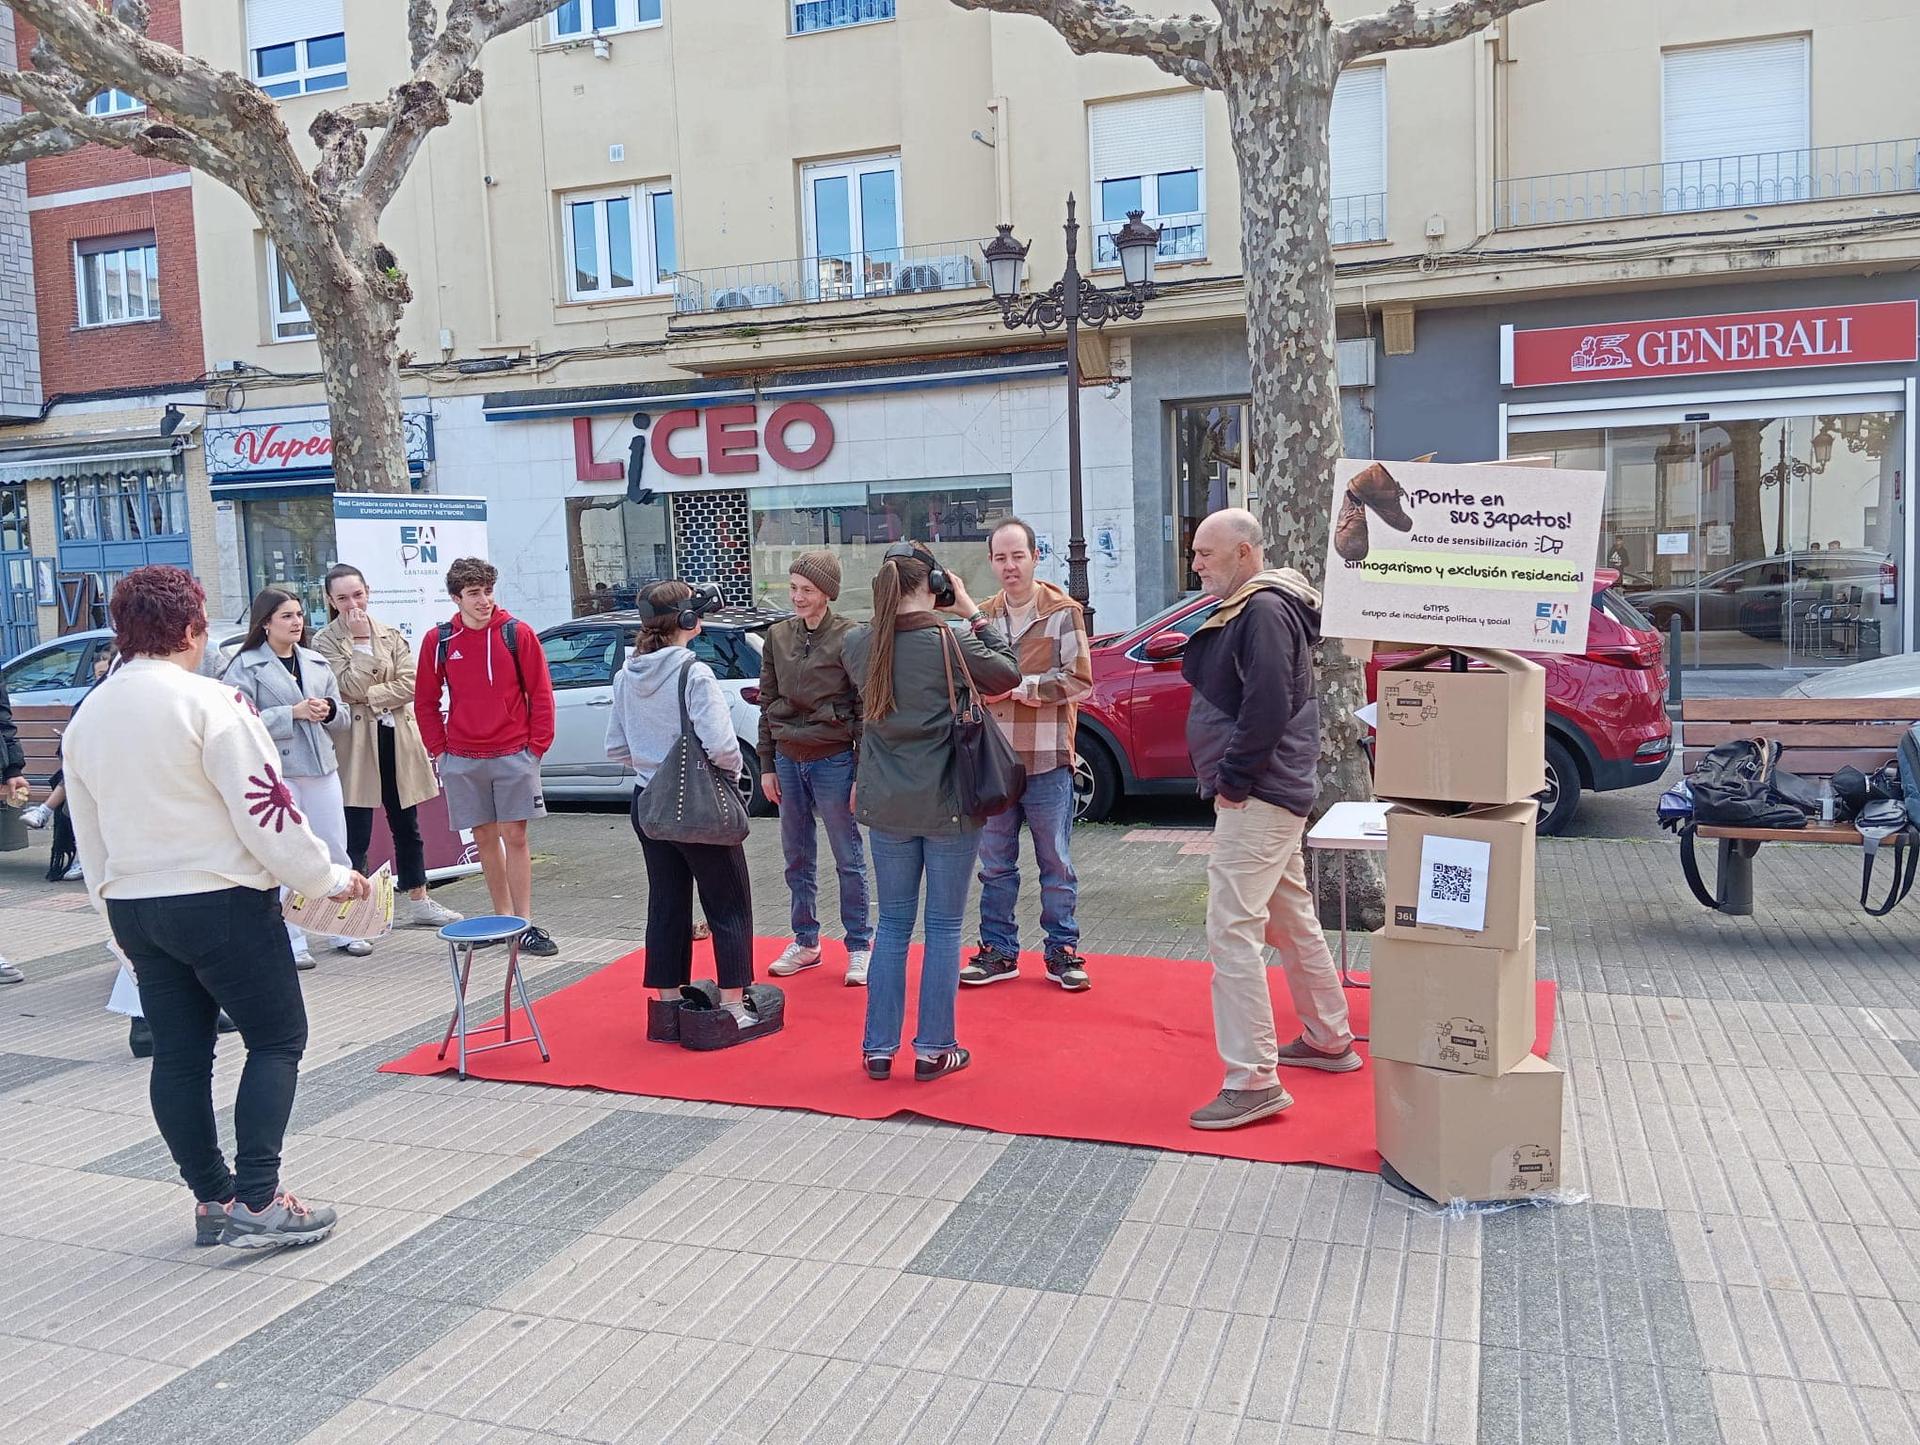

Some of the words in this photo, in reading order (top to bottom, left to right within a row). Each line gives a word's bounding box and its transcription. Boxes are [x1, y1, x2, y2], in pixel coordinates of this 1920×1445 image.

[1637, 317, 1853, 367] GENERALI
[1409, 489, 1475, 508] ¡Ponte
[1480, 493, 1504, 507] en
[1450, 510, 1479, 524] sus
[1483, 510, 1572, 531] zapatos!
[1411, 533, 1434, 544] Acto
[1437, 535, 1450, 545] de
[1452, 536, 1528, 549] sensibilización
[1344, 559, 1432, 575] Sinhogarismo
[1435, 566, 1444, 579] y
[1447, 565, 1507, 580] exclusión
[1511, 569, 1584, 583] residencial
[1362, 609, 1387, 620] Grupo
[1389, 611, 1400, 619] de
[1402, 611, 1443, 622] incidencia
[1445, 613, 1477, 625] política
[1487, 617, 1511, 626] social
[1396, 911, 1415, 921] 36L
